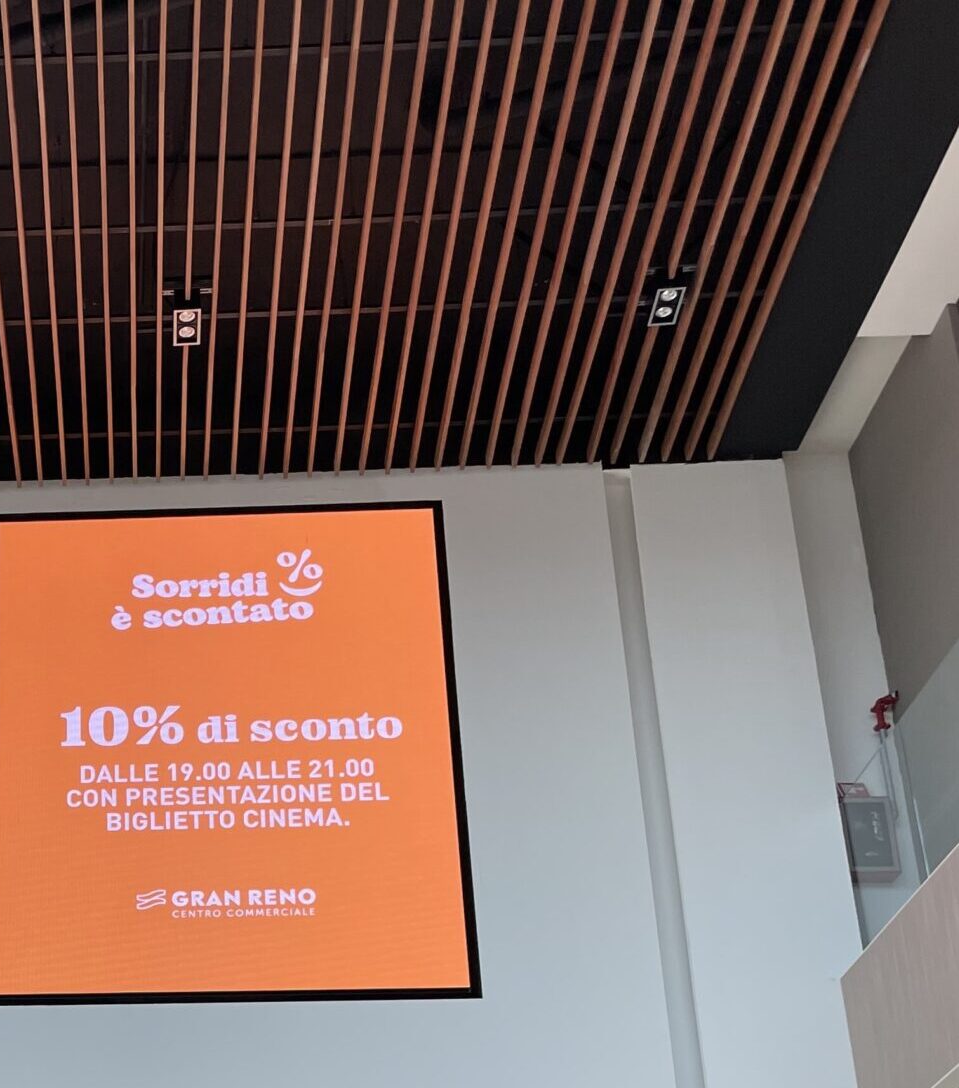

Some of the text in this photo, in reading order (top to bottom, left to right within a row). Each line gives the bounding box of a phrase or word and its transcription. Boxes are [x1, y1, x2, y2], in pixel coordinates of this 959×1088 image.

[131, 571, 270, 599] Sorridi
[110, 597, 314, 631] è scontato
[59, 704, 403, 747] 10% di sconto
[79, 757, 375, 784] DALLE 19.00 ALLE 21.00
[66, 781, 390, 808] CON PRESENTAZIONE DEL
[106, 807, 350, 832] BIGLIETTO CINEMA.
[171, 887, 317, 908] GRAN RENO
[171, 907, 316, 918] CENTRO COMMERCIALE
